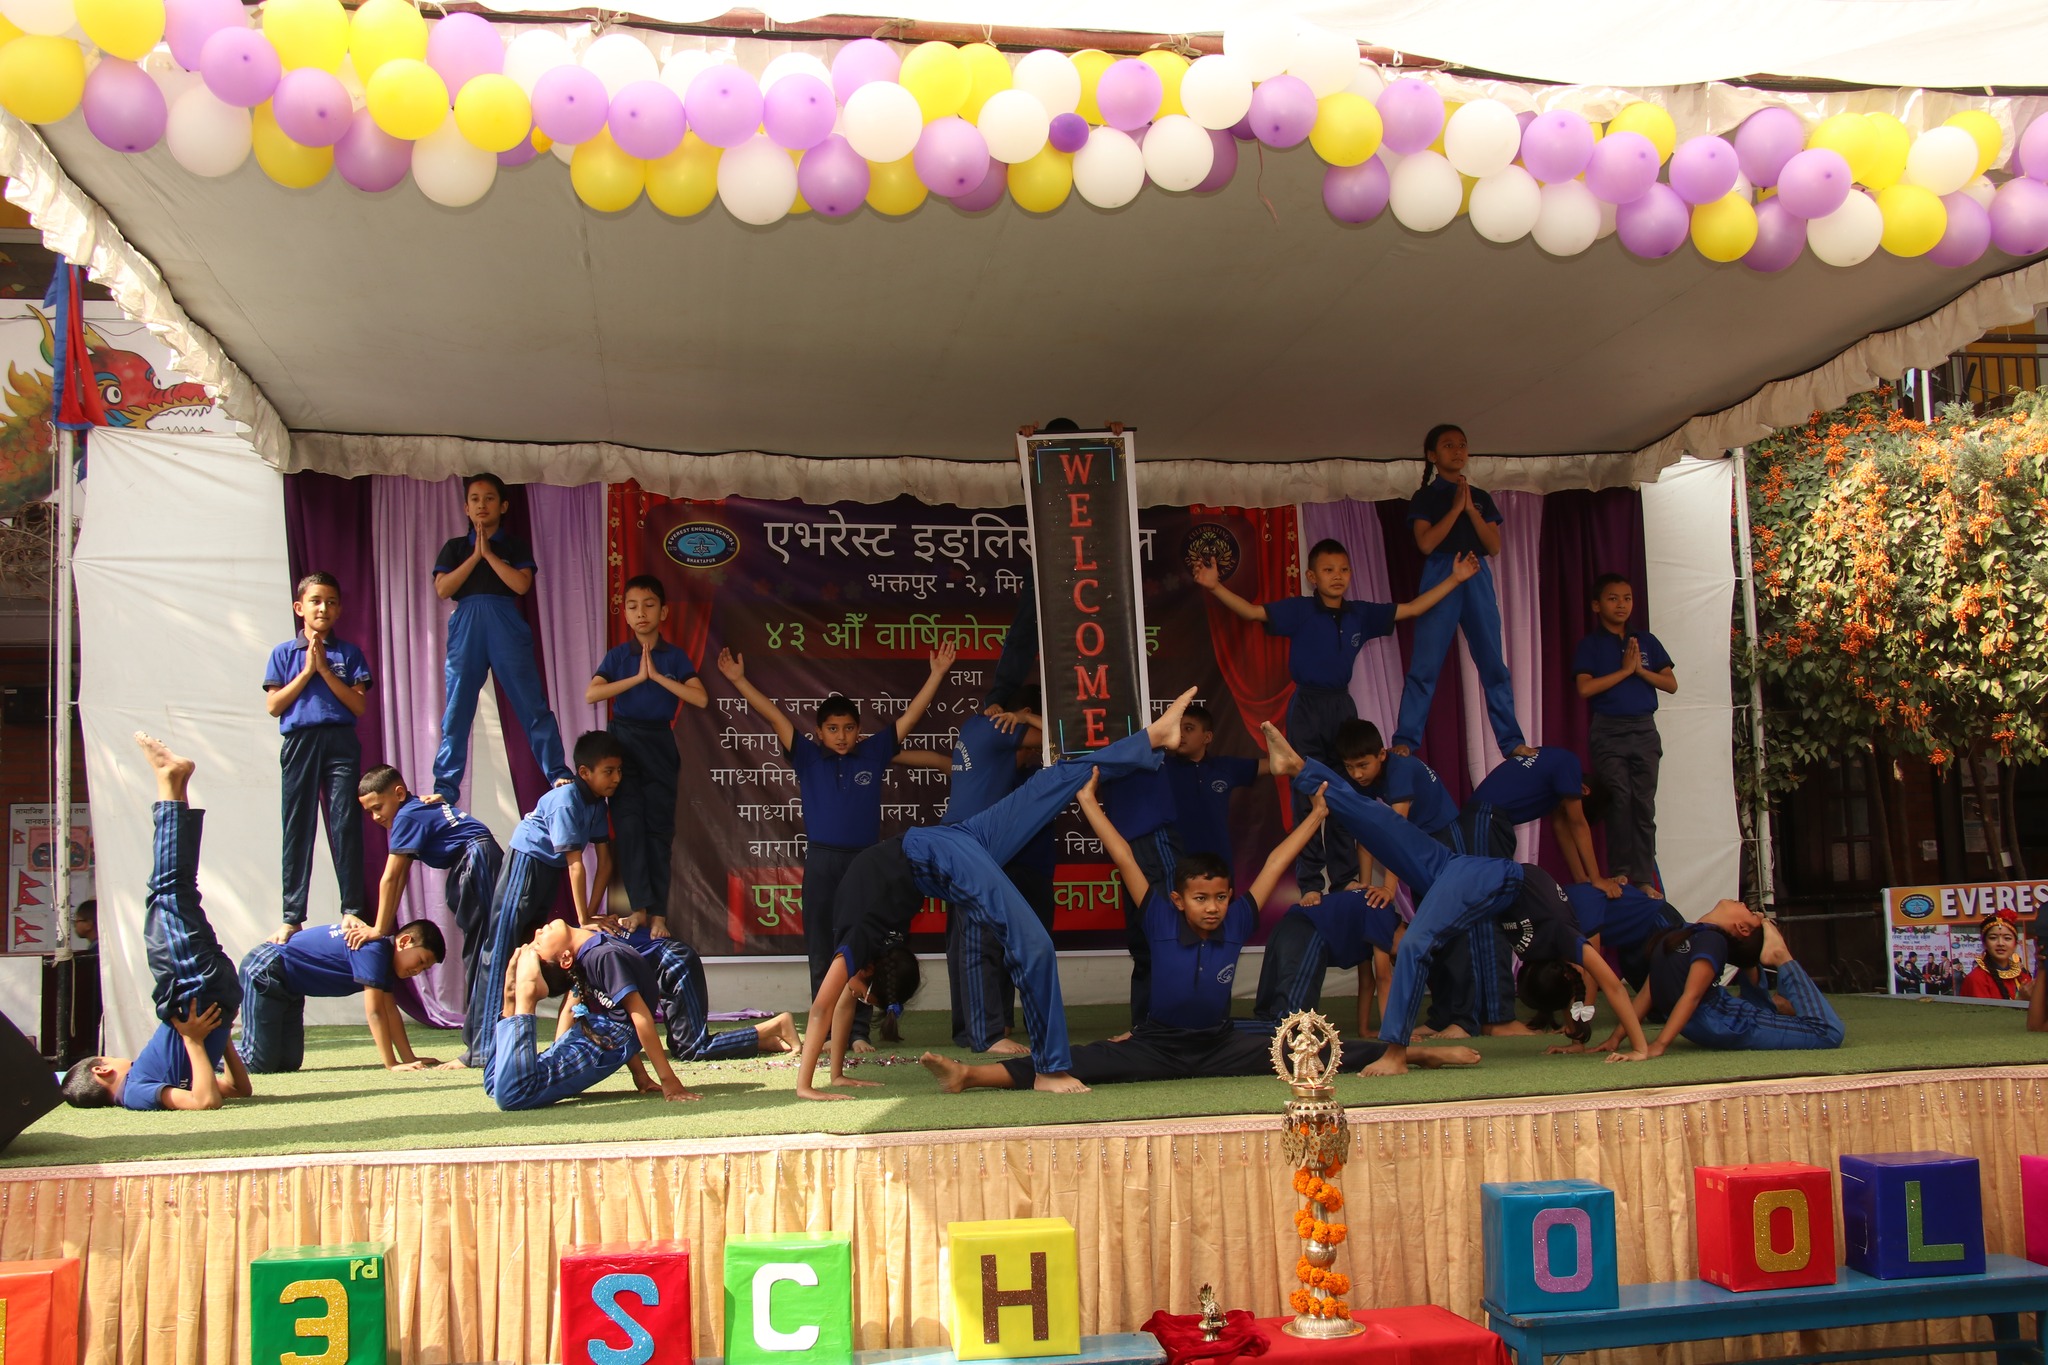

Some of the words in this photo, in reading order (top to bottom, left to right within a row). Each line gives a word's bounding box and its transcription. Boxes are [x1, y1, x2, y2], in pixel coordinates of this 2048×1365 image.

[668, 527, 690, 545] EVEREST
[715, 529, 735, 546] SCHOOL
[763, 510, 897, 564] एभरेस्ट
[867, 573, 938, 599] भक्तपुर
[1059, 454, 1111, 748] WELCOME
[765, 622, 806, 651] ४३
[950, 670, 983, 686] तथा
[719, 726, 780, 757] टीकापु
[1939, 884, 2048, 917] EVERES
[1533, 1207, 1593, 1293] O
[1753, 1188, 1812, 1273] O
[1905, 1180, 1965, 1262] L
[587, 1273, 659, 1365] S
[752, 1262, 820, 1351] C
[980, 1252, 1049, 1344] H
